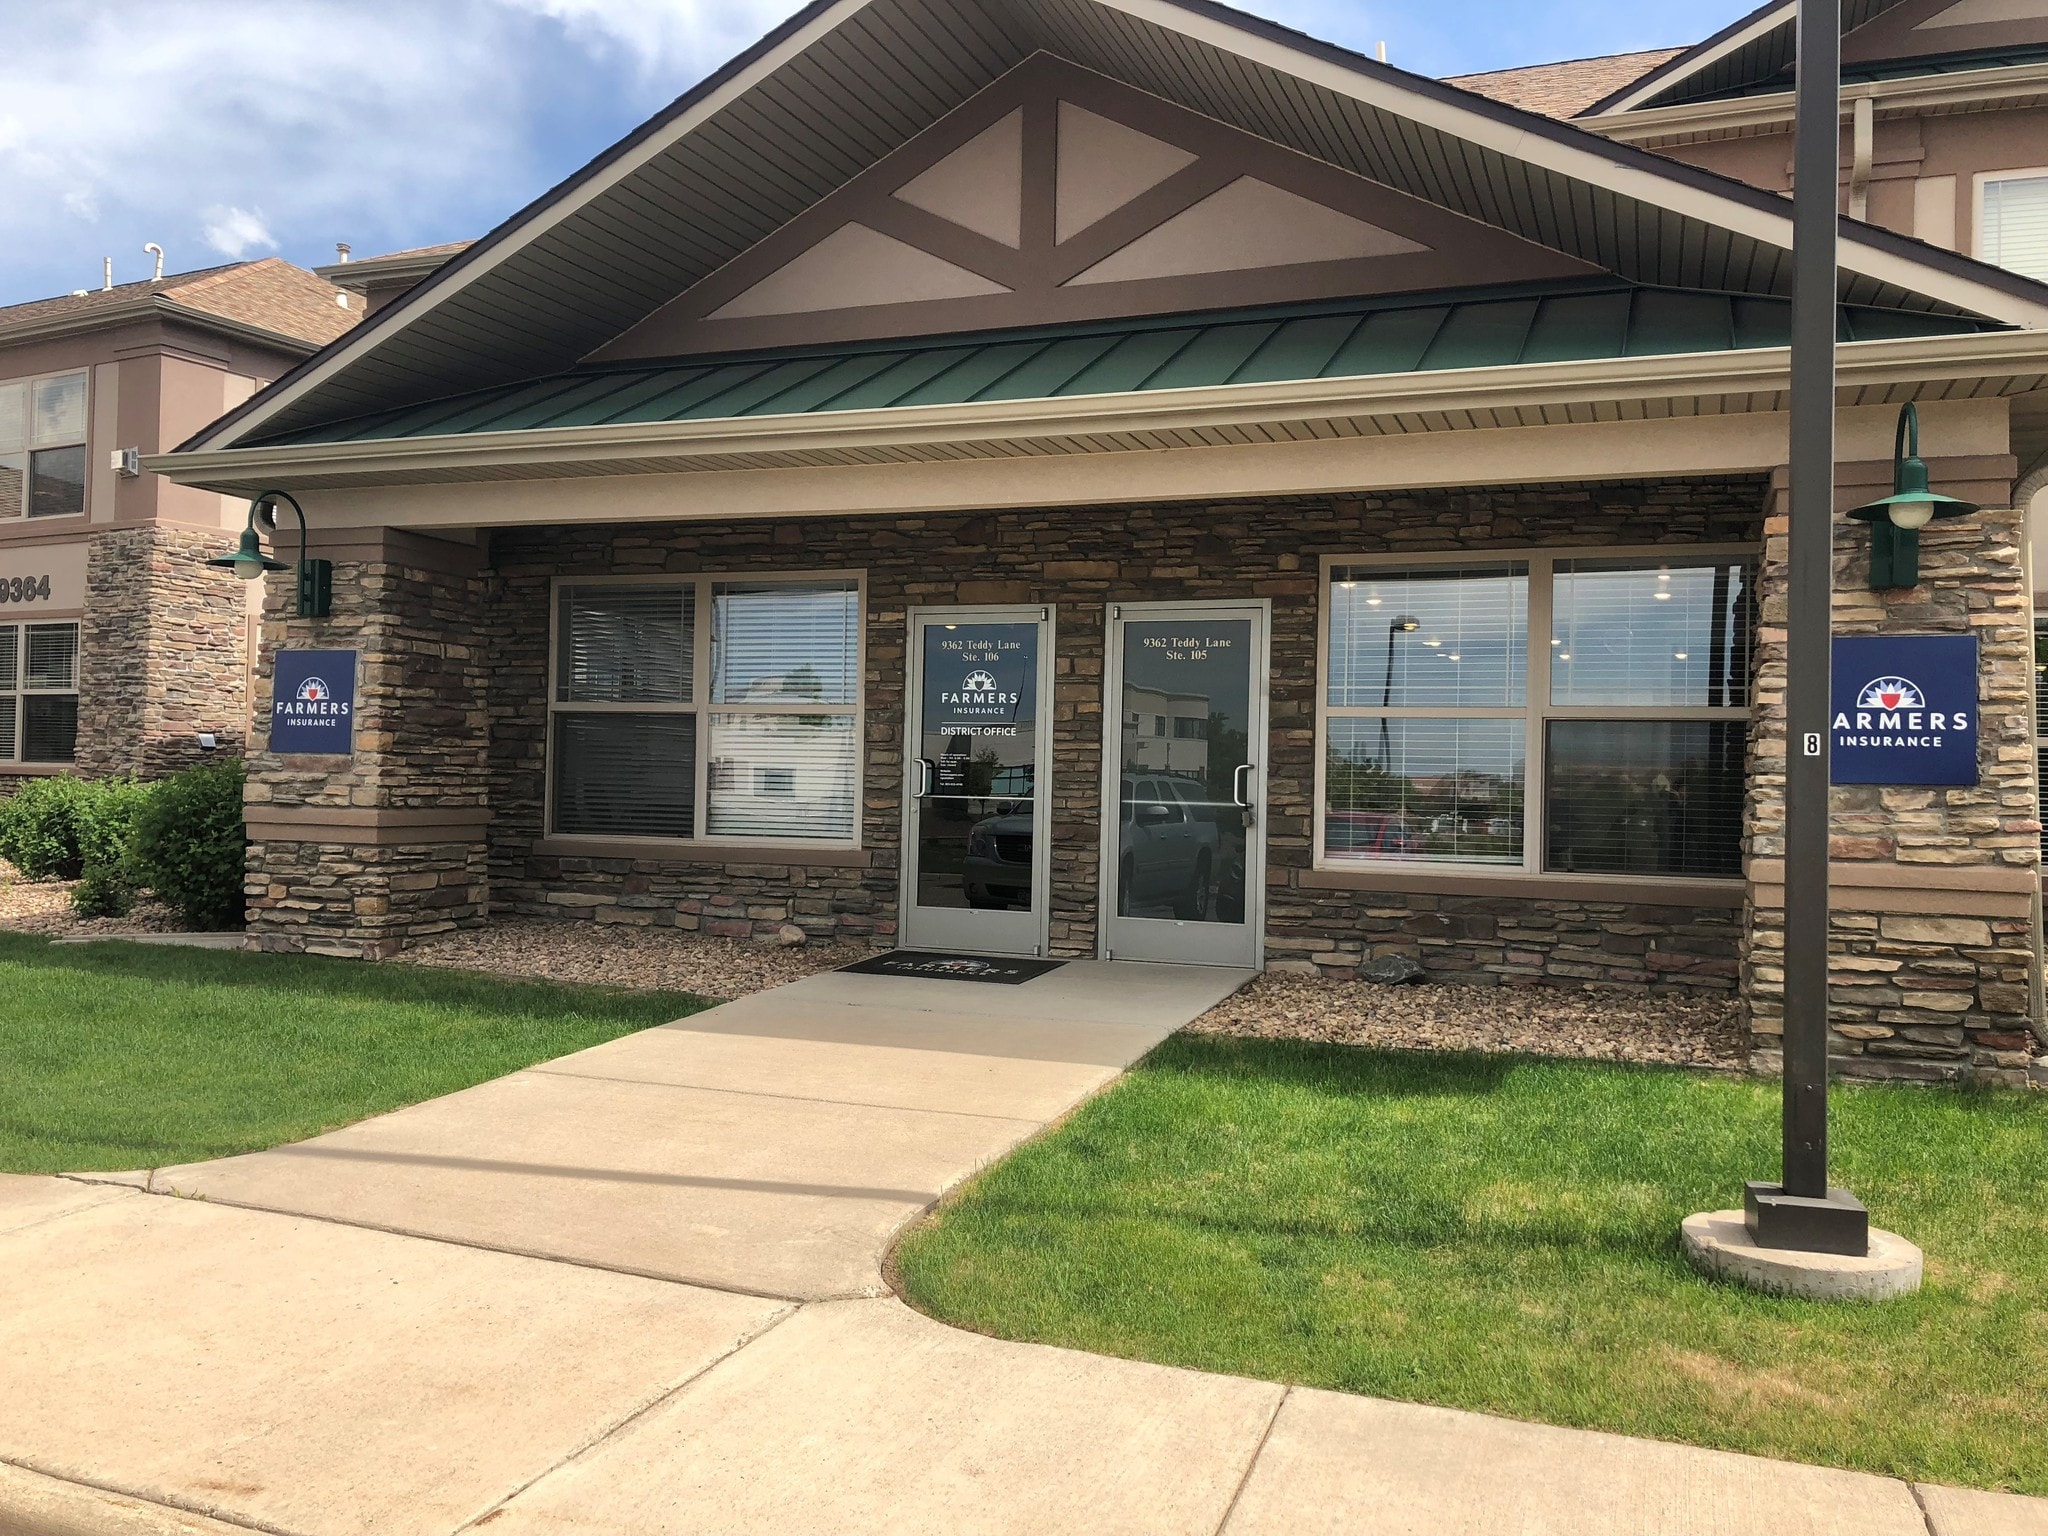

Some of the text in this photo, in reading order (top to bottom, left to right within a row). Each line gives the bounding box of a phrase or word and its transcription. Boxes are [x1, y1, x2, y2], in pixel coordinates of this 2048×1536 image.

[0, 575, 51, 604] 9364
[941, 640, 1021, 651] 9362 Teddy Lane
[1143, 637, 1232, 649] 9362 Teddy Lane
[962, 652, 1000, 662] Ste. 106
[1166, 650, 1208, 660] Ste. 105
[941, 692, 1018, 704] FARMERS
[276, 702, 349, 715] FARMERS
[953, 707, 1005, 715] INSURANCE
[287, 718, 336, 727] INSURANCE
[1831, 712, 1968, 731] ARMERS
[941, 727, 1017, 736] DISTRICT OFFICE
[1807, 735, 1818, 754] 8
[1839, 736, 1942, 747] INSURANCE
